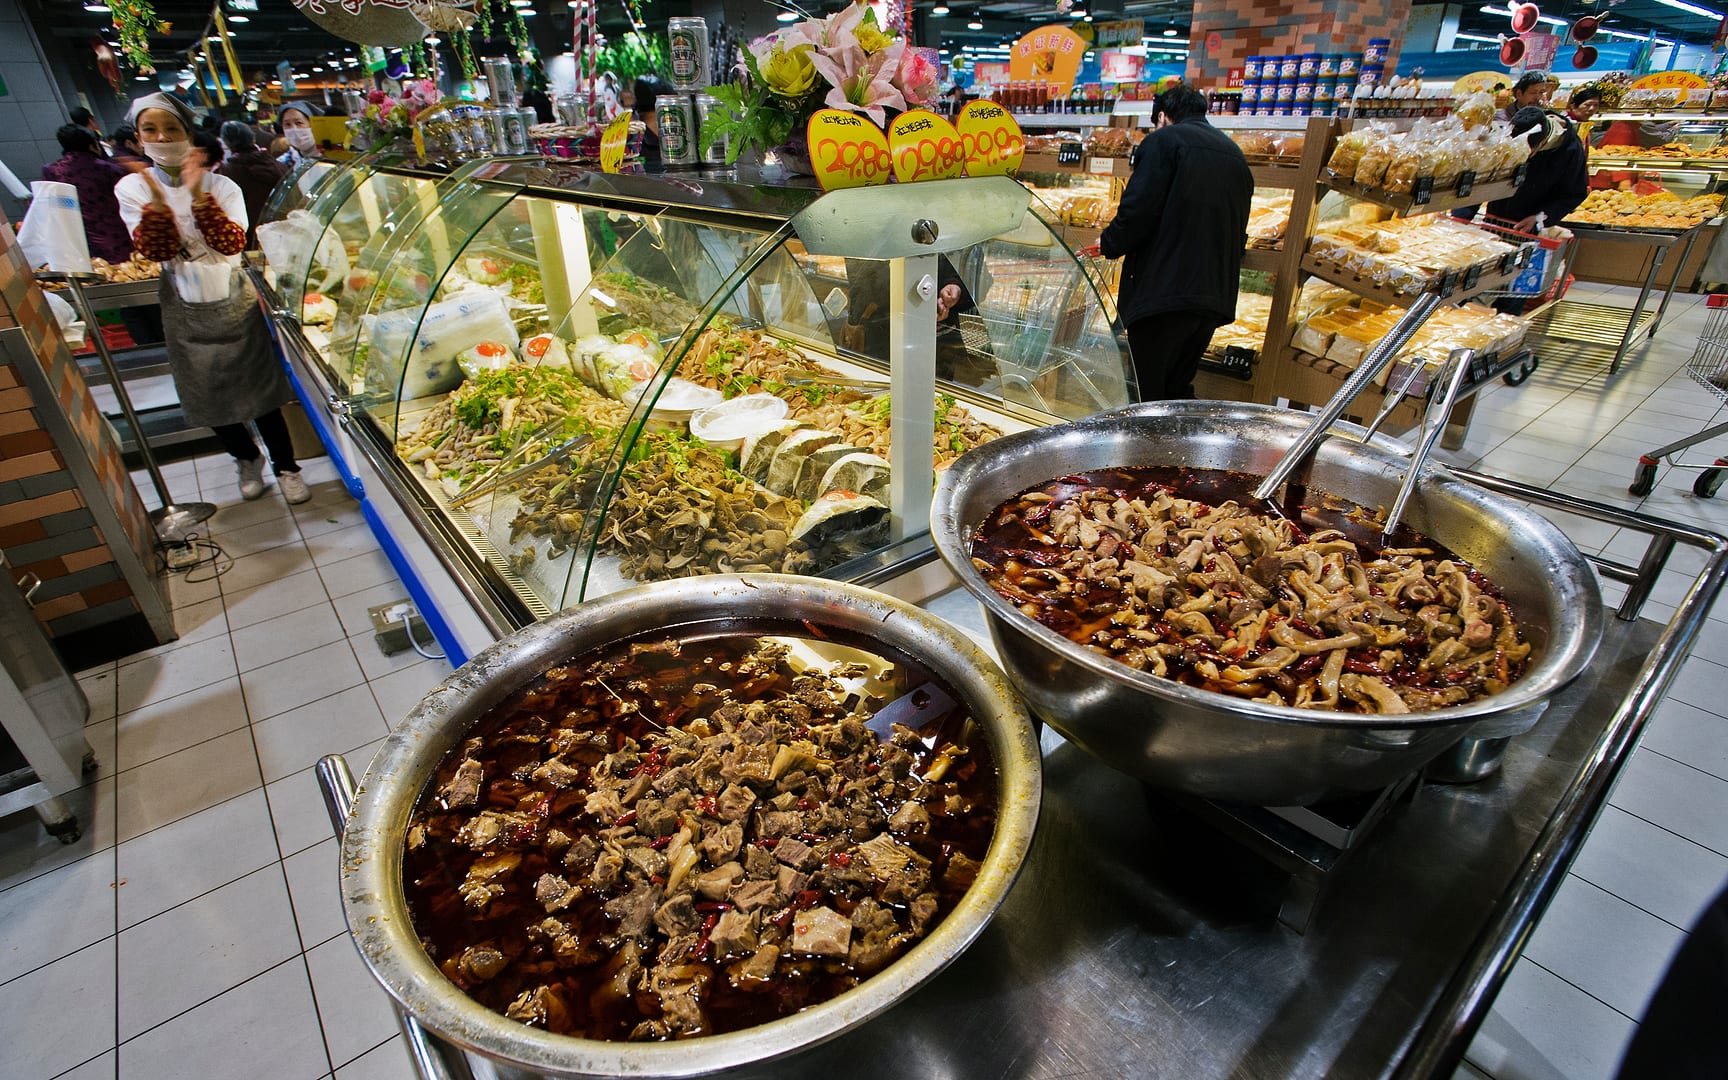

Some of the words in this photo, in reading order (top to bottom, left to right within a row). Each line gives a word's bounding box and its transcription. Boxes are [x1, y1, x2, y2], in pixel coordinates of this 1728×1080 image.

[1020, 34, 1075, 57] 保证新鲜
[818, 138, 890, 181] 29.80
[900, 137, 964, 181] 29.80
[961, 127, 1021, 167] 29.80
